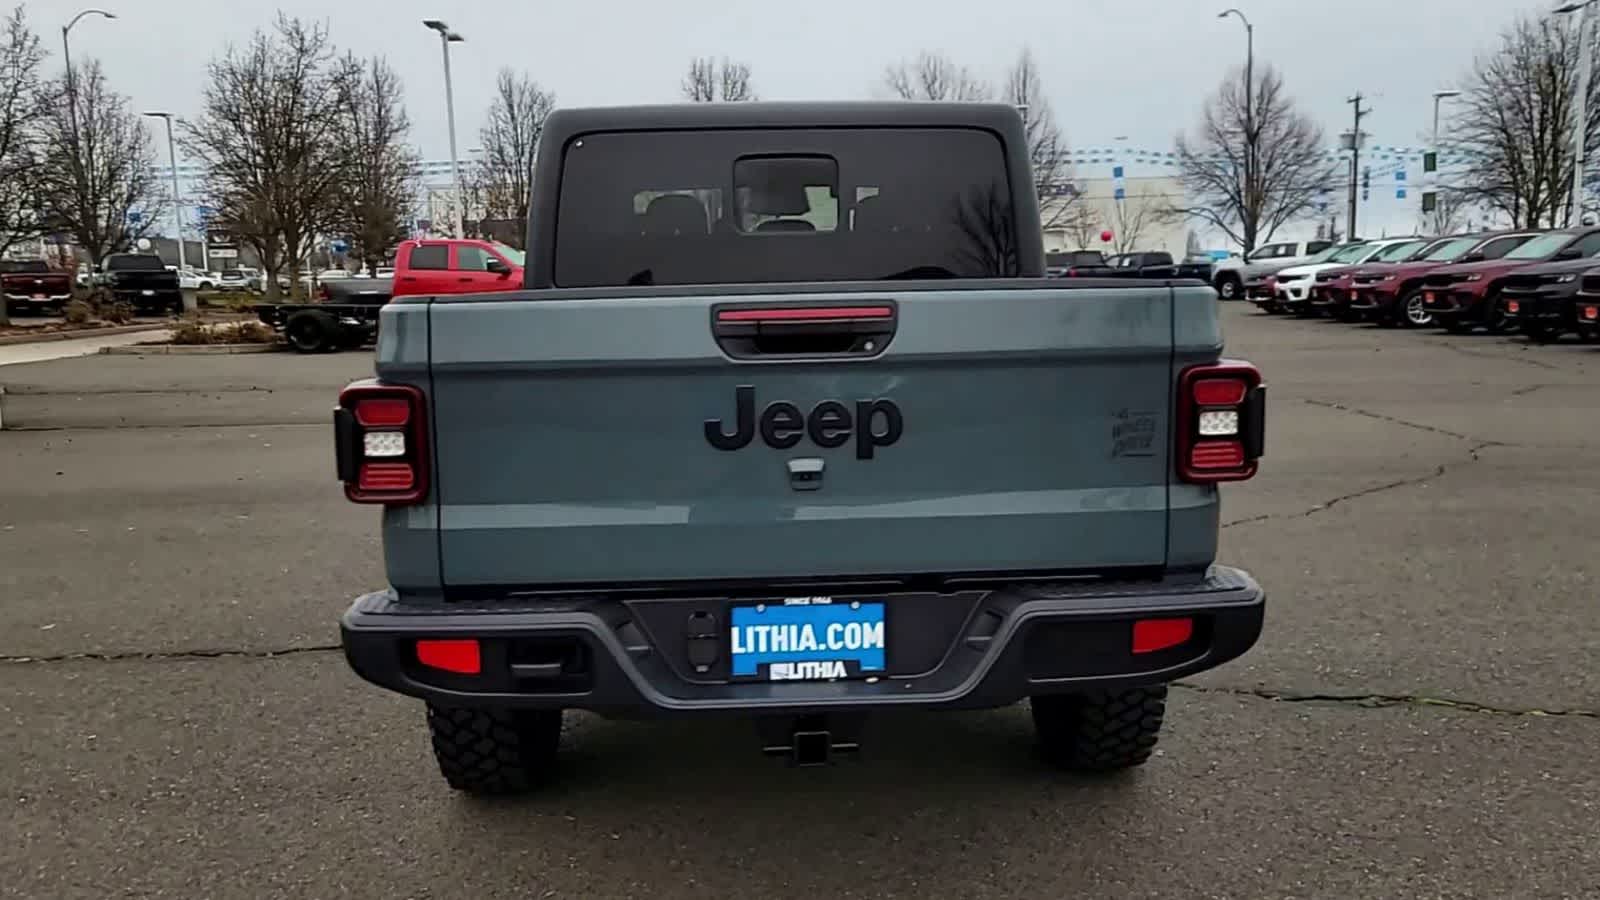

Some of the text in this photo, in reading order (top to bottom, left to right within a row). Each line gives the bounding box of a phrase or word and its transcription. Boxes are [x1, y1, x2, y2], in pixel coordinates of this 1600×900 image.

[704, 384, 903, 460] Jeep
[731, 621, 885, 654] LITHIA.COM
[789, 660, 848, 680] LITHIA
